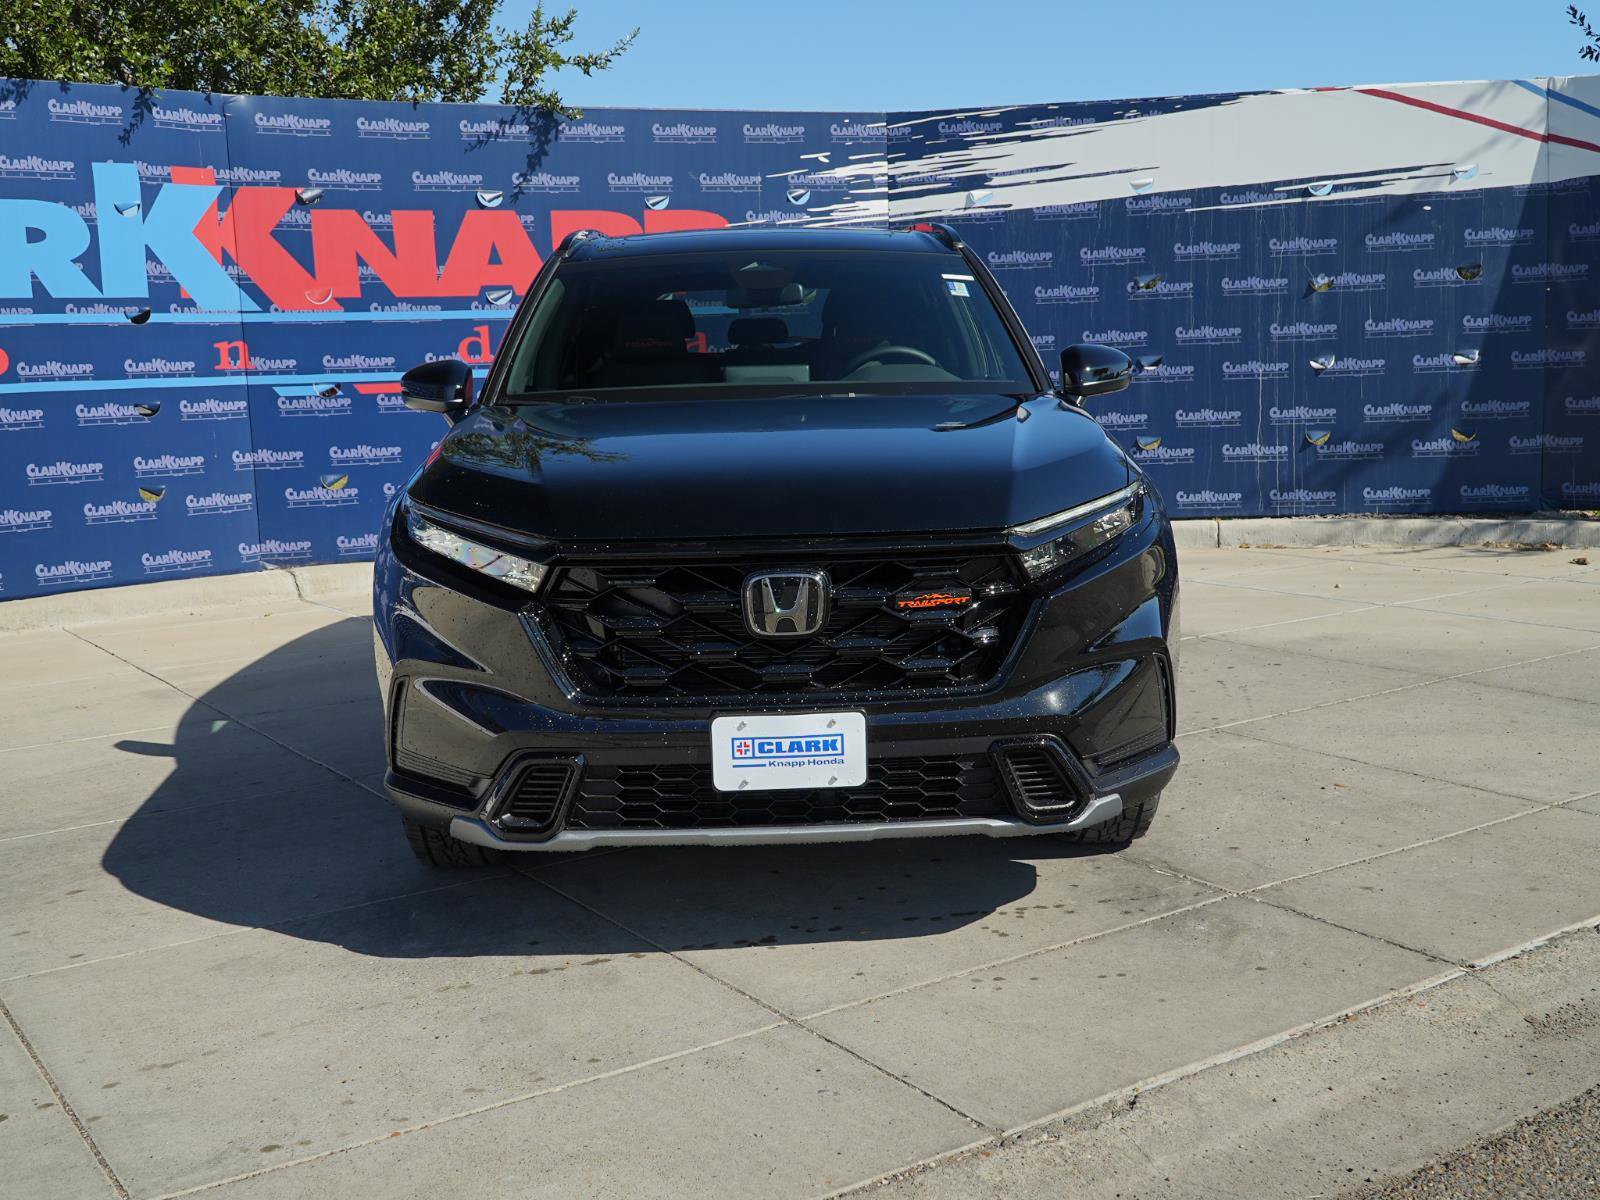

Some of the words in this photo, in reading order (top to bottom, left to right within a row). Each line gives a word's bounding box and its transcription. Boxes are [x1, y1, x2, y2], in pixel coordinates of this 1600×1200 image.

[758, 739, 838, 754] CLARK
[768, 760, 805, 768] Knapp
[808, 758, 844, 766] Honda
